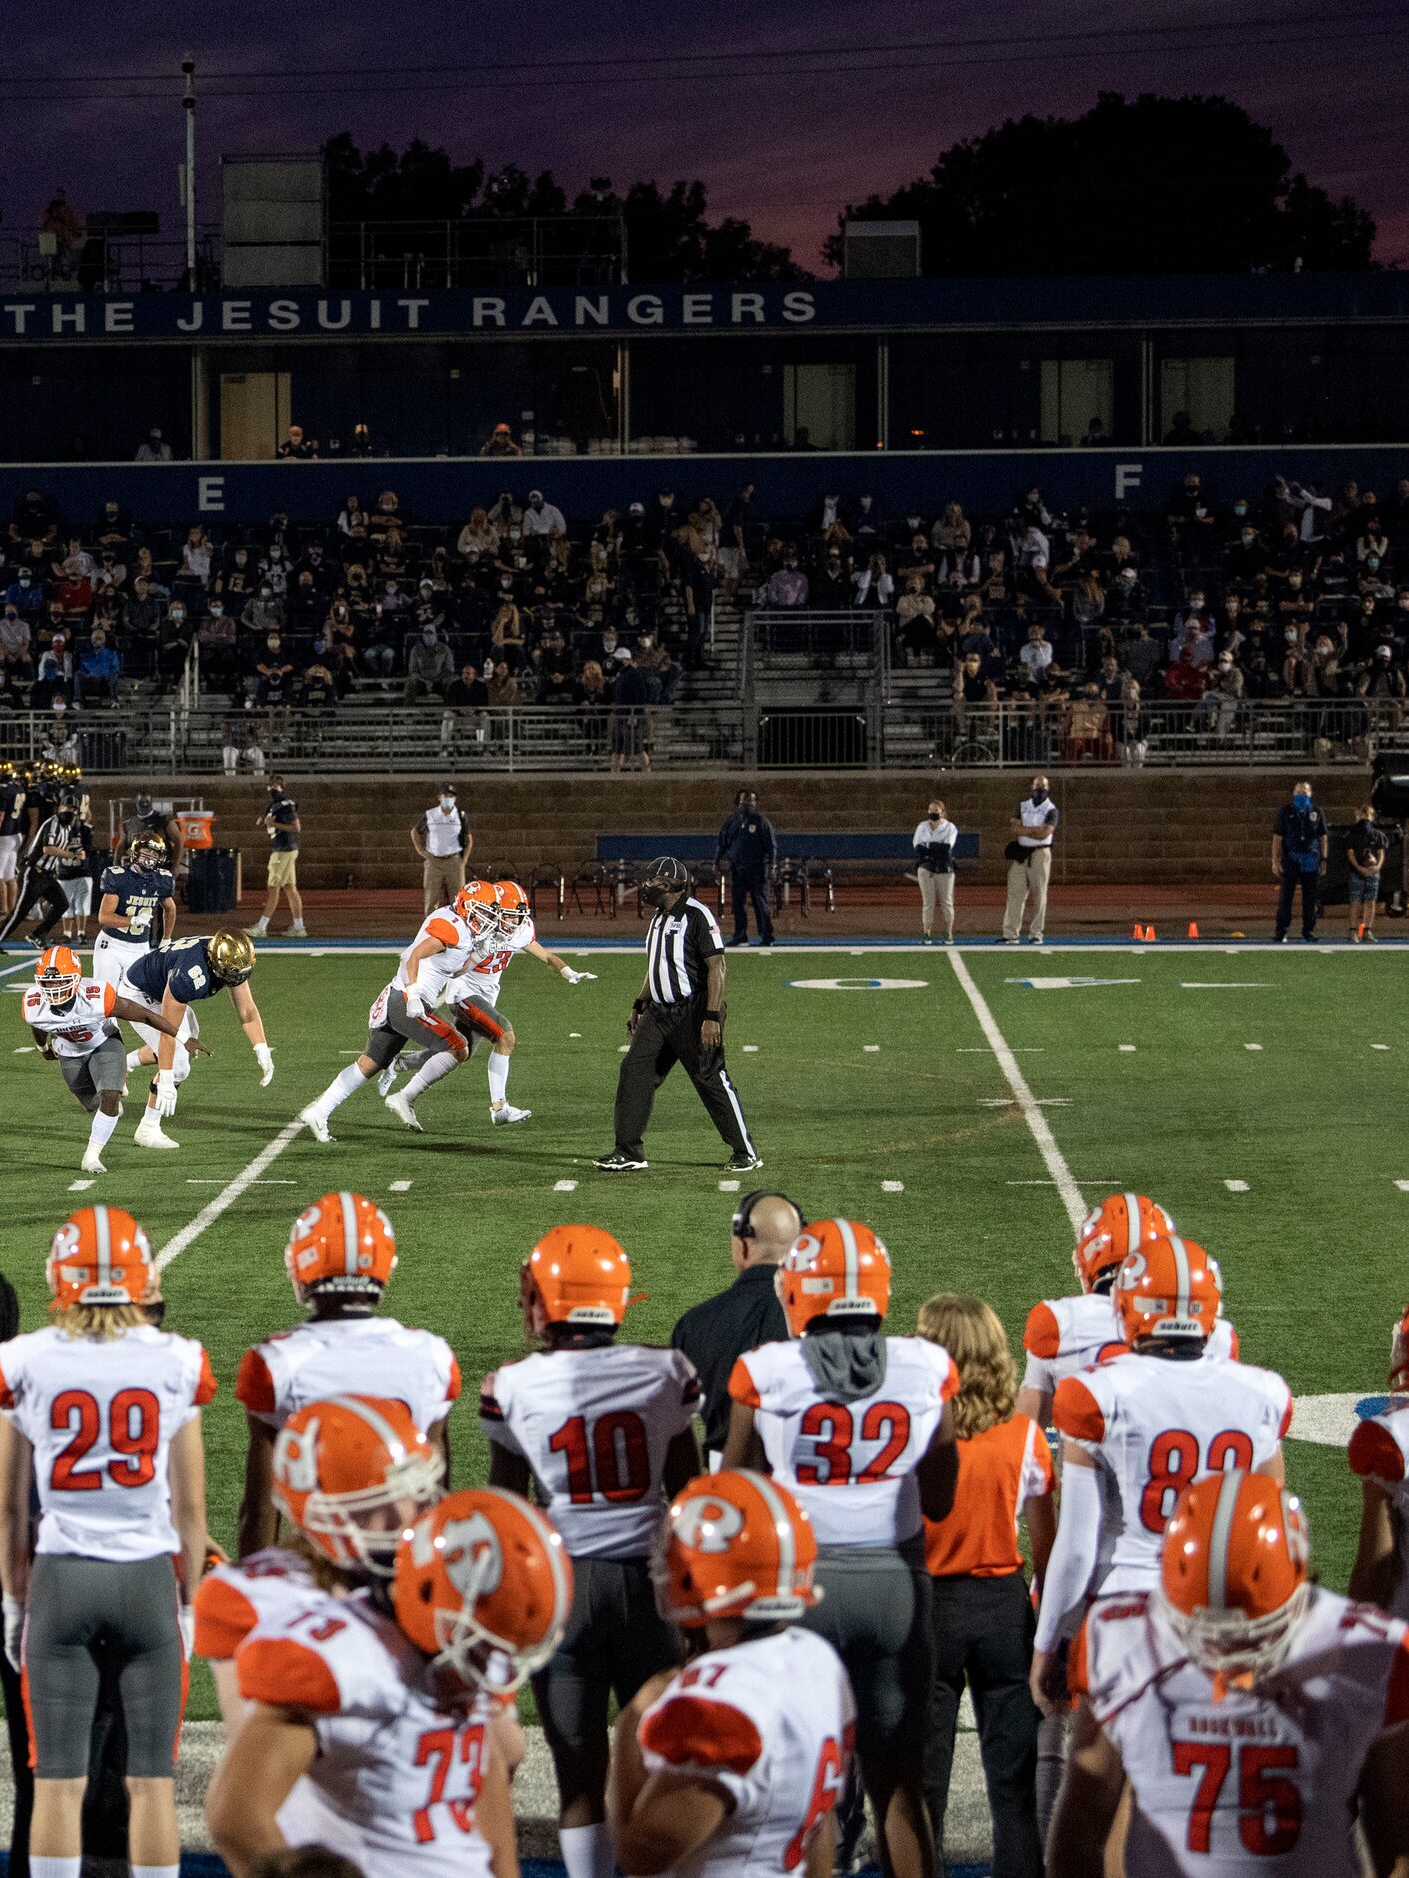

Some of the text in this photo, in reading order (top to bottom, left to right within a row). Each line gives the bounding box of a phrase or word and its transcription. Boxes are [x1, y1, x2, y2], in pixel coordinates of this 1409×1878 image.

[3, 302, 136, 334] THE
[177, 298, 430, 332] JESUIT
[472, 292, 816, 327] RANGERS
[198, 476, 225, 511] E
[1115, 464, 1142, 499] F
[125, 895, 159, 907] JESUIT
[474, 951, 511, 975] 23
[85, 985, 101, 1001] 15
[49, 1387, 161, 1491] 29
[549, 1410, 652, 1505] 10
[796, 1400, 911, 1486] 32
[672, 1494, 745, 1554] R
[413, 1724, 485, 1845] 73
[1171, 1740, 1304, 1857] 75
